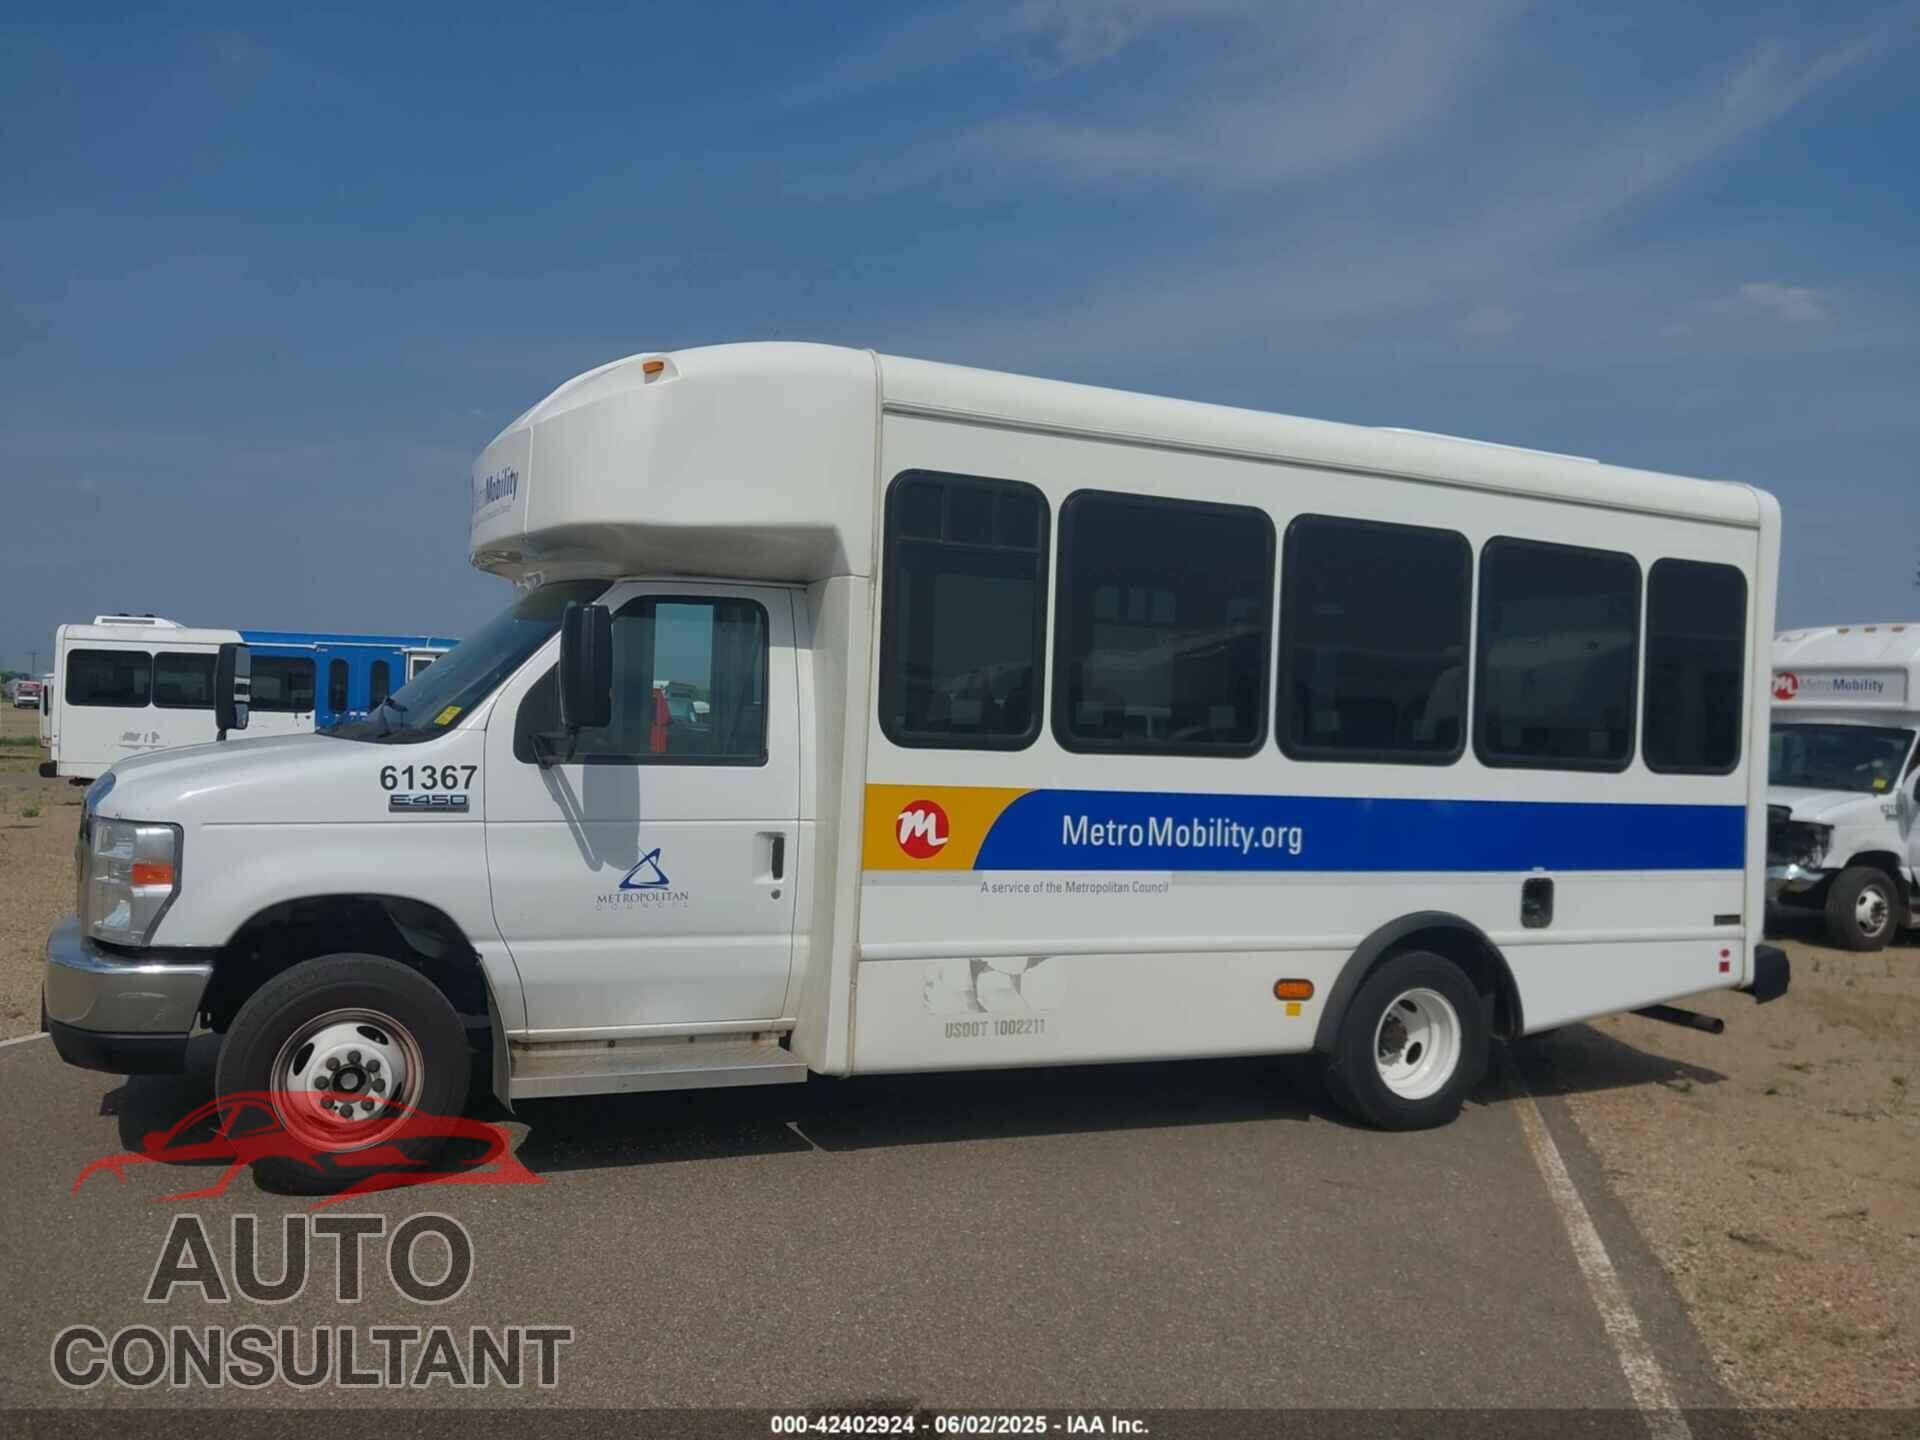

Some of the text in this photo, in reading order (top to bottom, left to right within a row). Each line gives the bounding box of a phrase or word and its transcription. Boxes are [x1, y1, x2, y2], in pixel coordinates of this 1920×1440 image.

[380, 765, 478, 790] 61367
[980, 881, 1169, 896] A service of the Metropolitan Council
[596, 892, 689, 904] METROPOLITAN
[945, 1021, 988, 1039] USDOT
